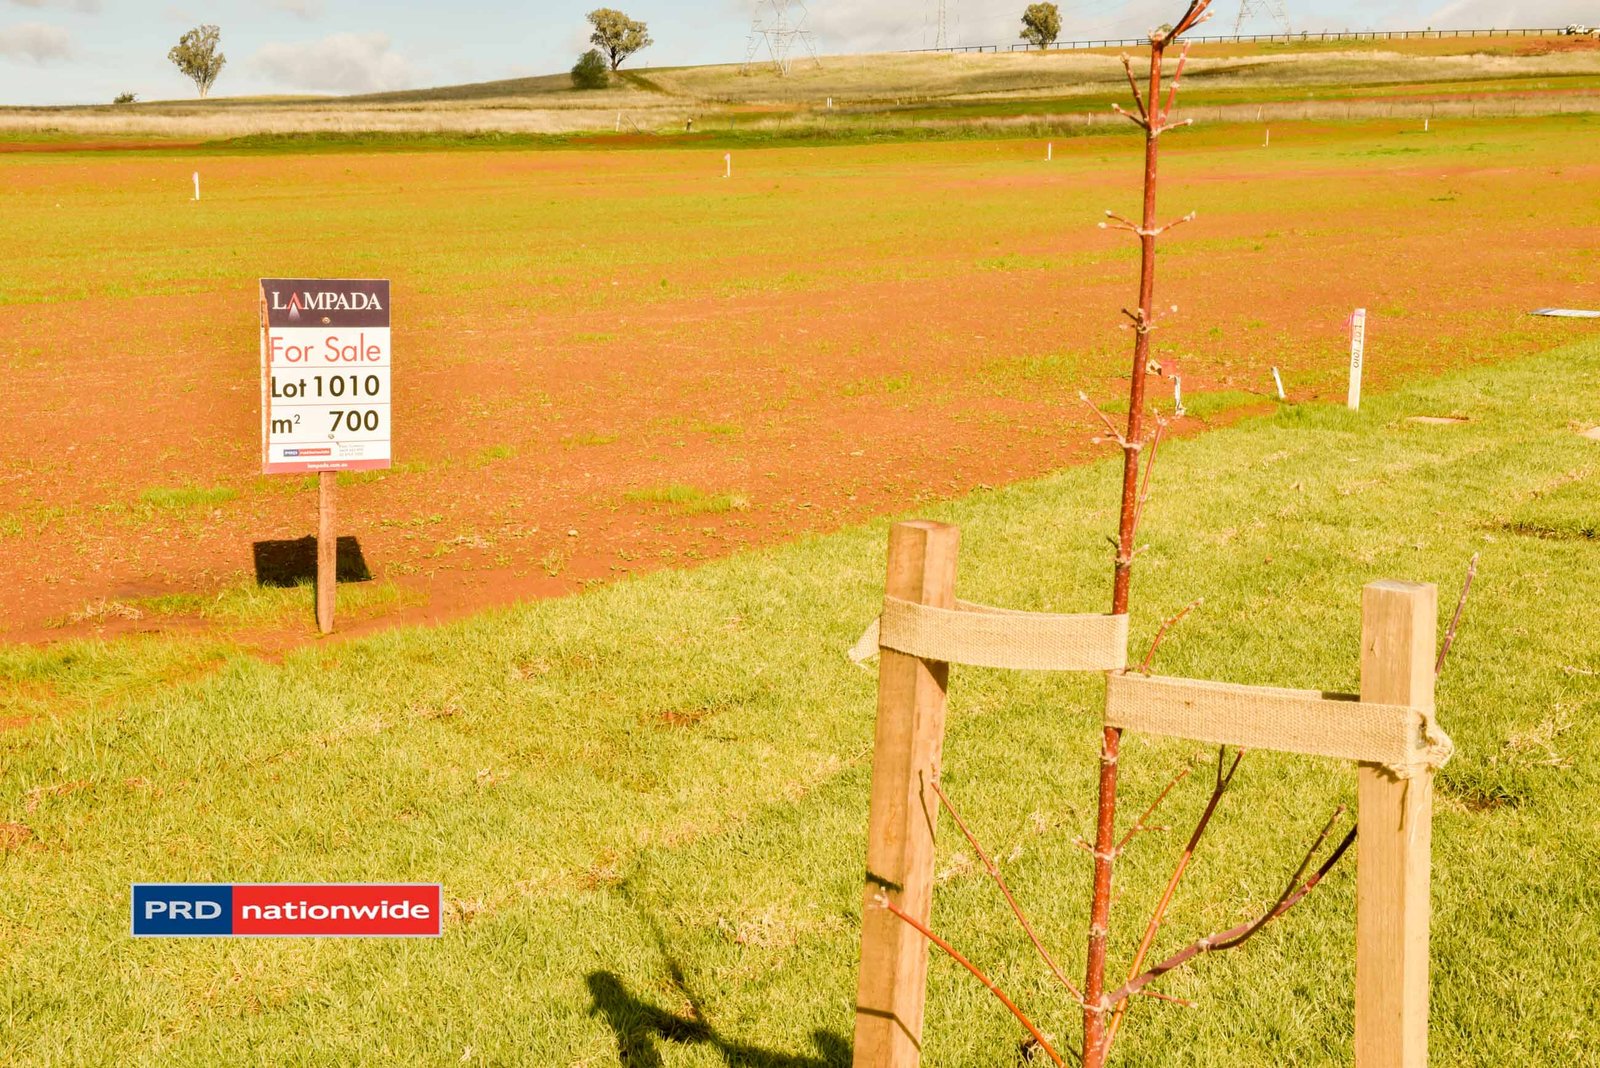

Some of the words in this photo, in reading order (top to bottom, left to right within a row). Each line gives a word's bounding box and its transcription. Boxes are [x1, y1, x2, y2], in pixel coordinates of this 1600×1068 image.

[271, 291, 383, 312] LAMPADA
[1354, 325, 1362, 345] LOT
[270, 337, 314, 362] For
[324, 333, 381, 362] Sale
[271, 376, 307, 398] Lot
[313, 374, 380, 397] 1010
[329, 409, 379, 432] 700
